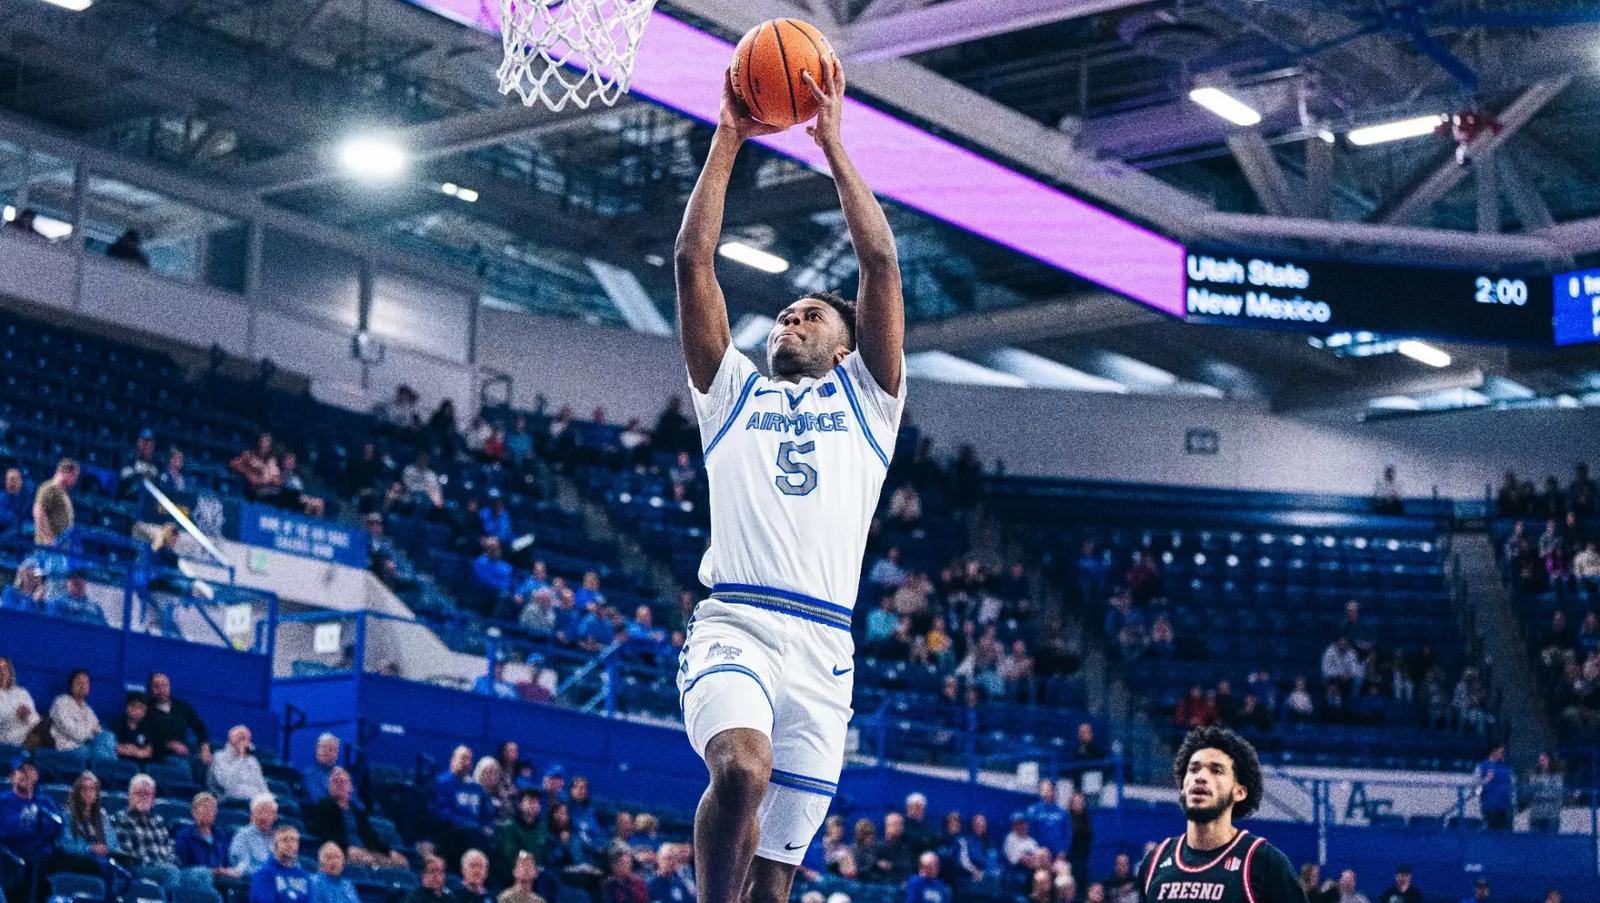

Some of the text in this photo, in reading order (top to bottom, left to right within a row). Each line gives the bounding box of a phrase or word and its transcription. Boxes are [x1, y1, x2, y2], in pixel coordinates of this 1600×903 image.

[1187, 255, 1310, 289] Utah State
[1187, 287, 1331, 322] New Mexico
[1475, 276, 1528, 306] 2:00
[775, 440, 817, 496] 5
[1157, 882, 1225, 900] FRESNO
